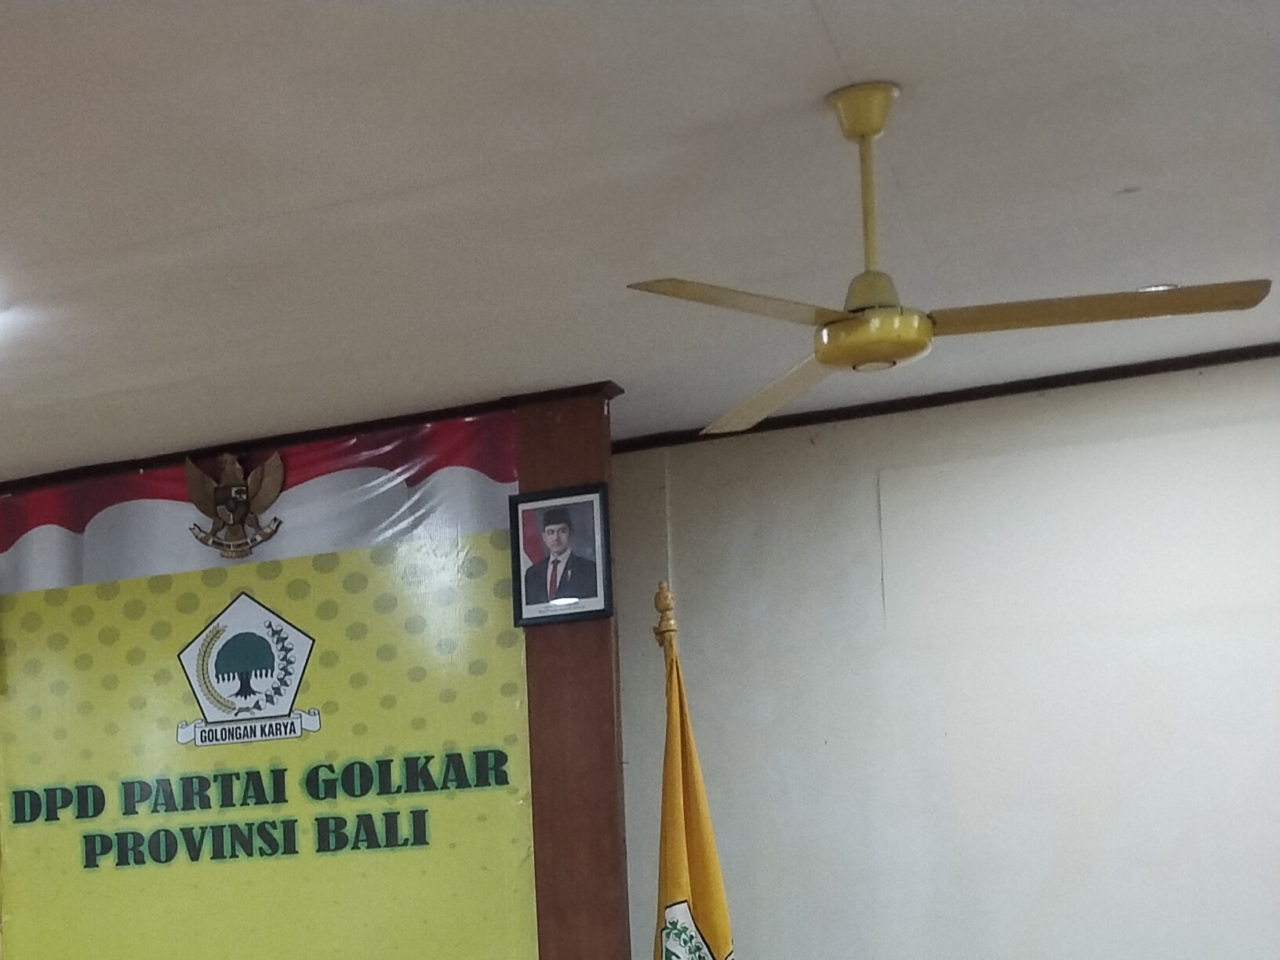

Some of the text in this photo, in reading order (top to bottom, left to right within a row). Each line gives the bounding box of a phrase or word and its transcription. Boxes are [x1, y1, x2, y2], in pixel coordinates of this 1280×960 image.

[200, 721, 297, 743] GOLONGAN KARYA
[12, 749, 510, 824] DPD PARTAI GOLKAR
[83, 809, 430, 869] PROVINSI BALI
